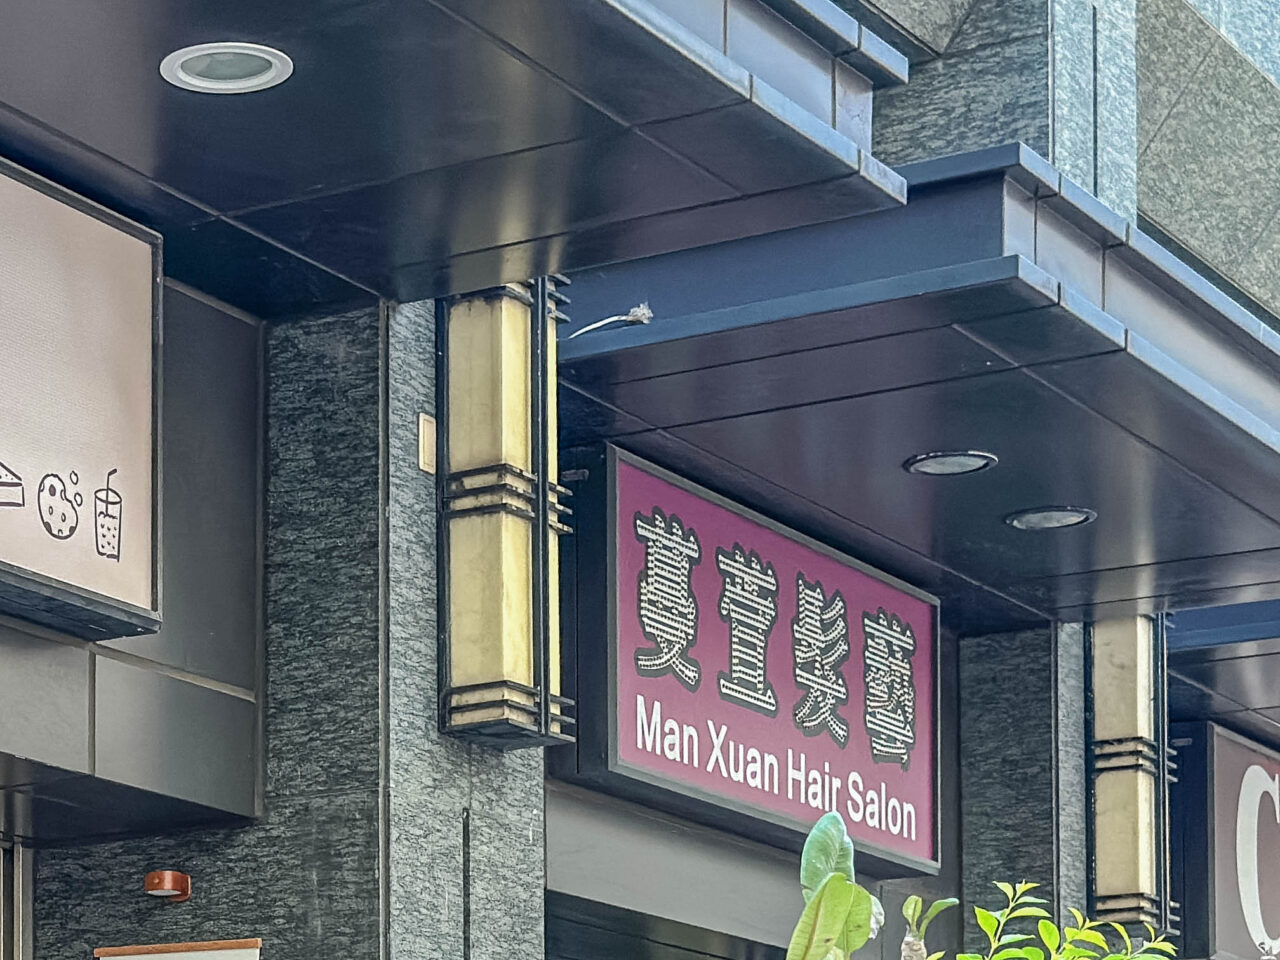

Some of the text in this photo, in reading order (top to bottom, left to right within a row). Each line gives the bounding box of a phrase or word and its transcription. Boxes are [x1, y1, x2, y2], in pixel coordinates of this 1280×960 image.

[636, 694, 917, 841] Man Xuan Hair Salon
